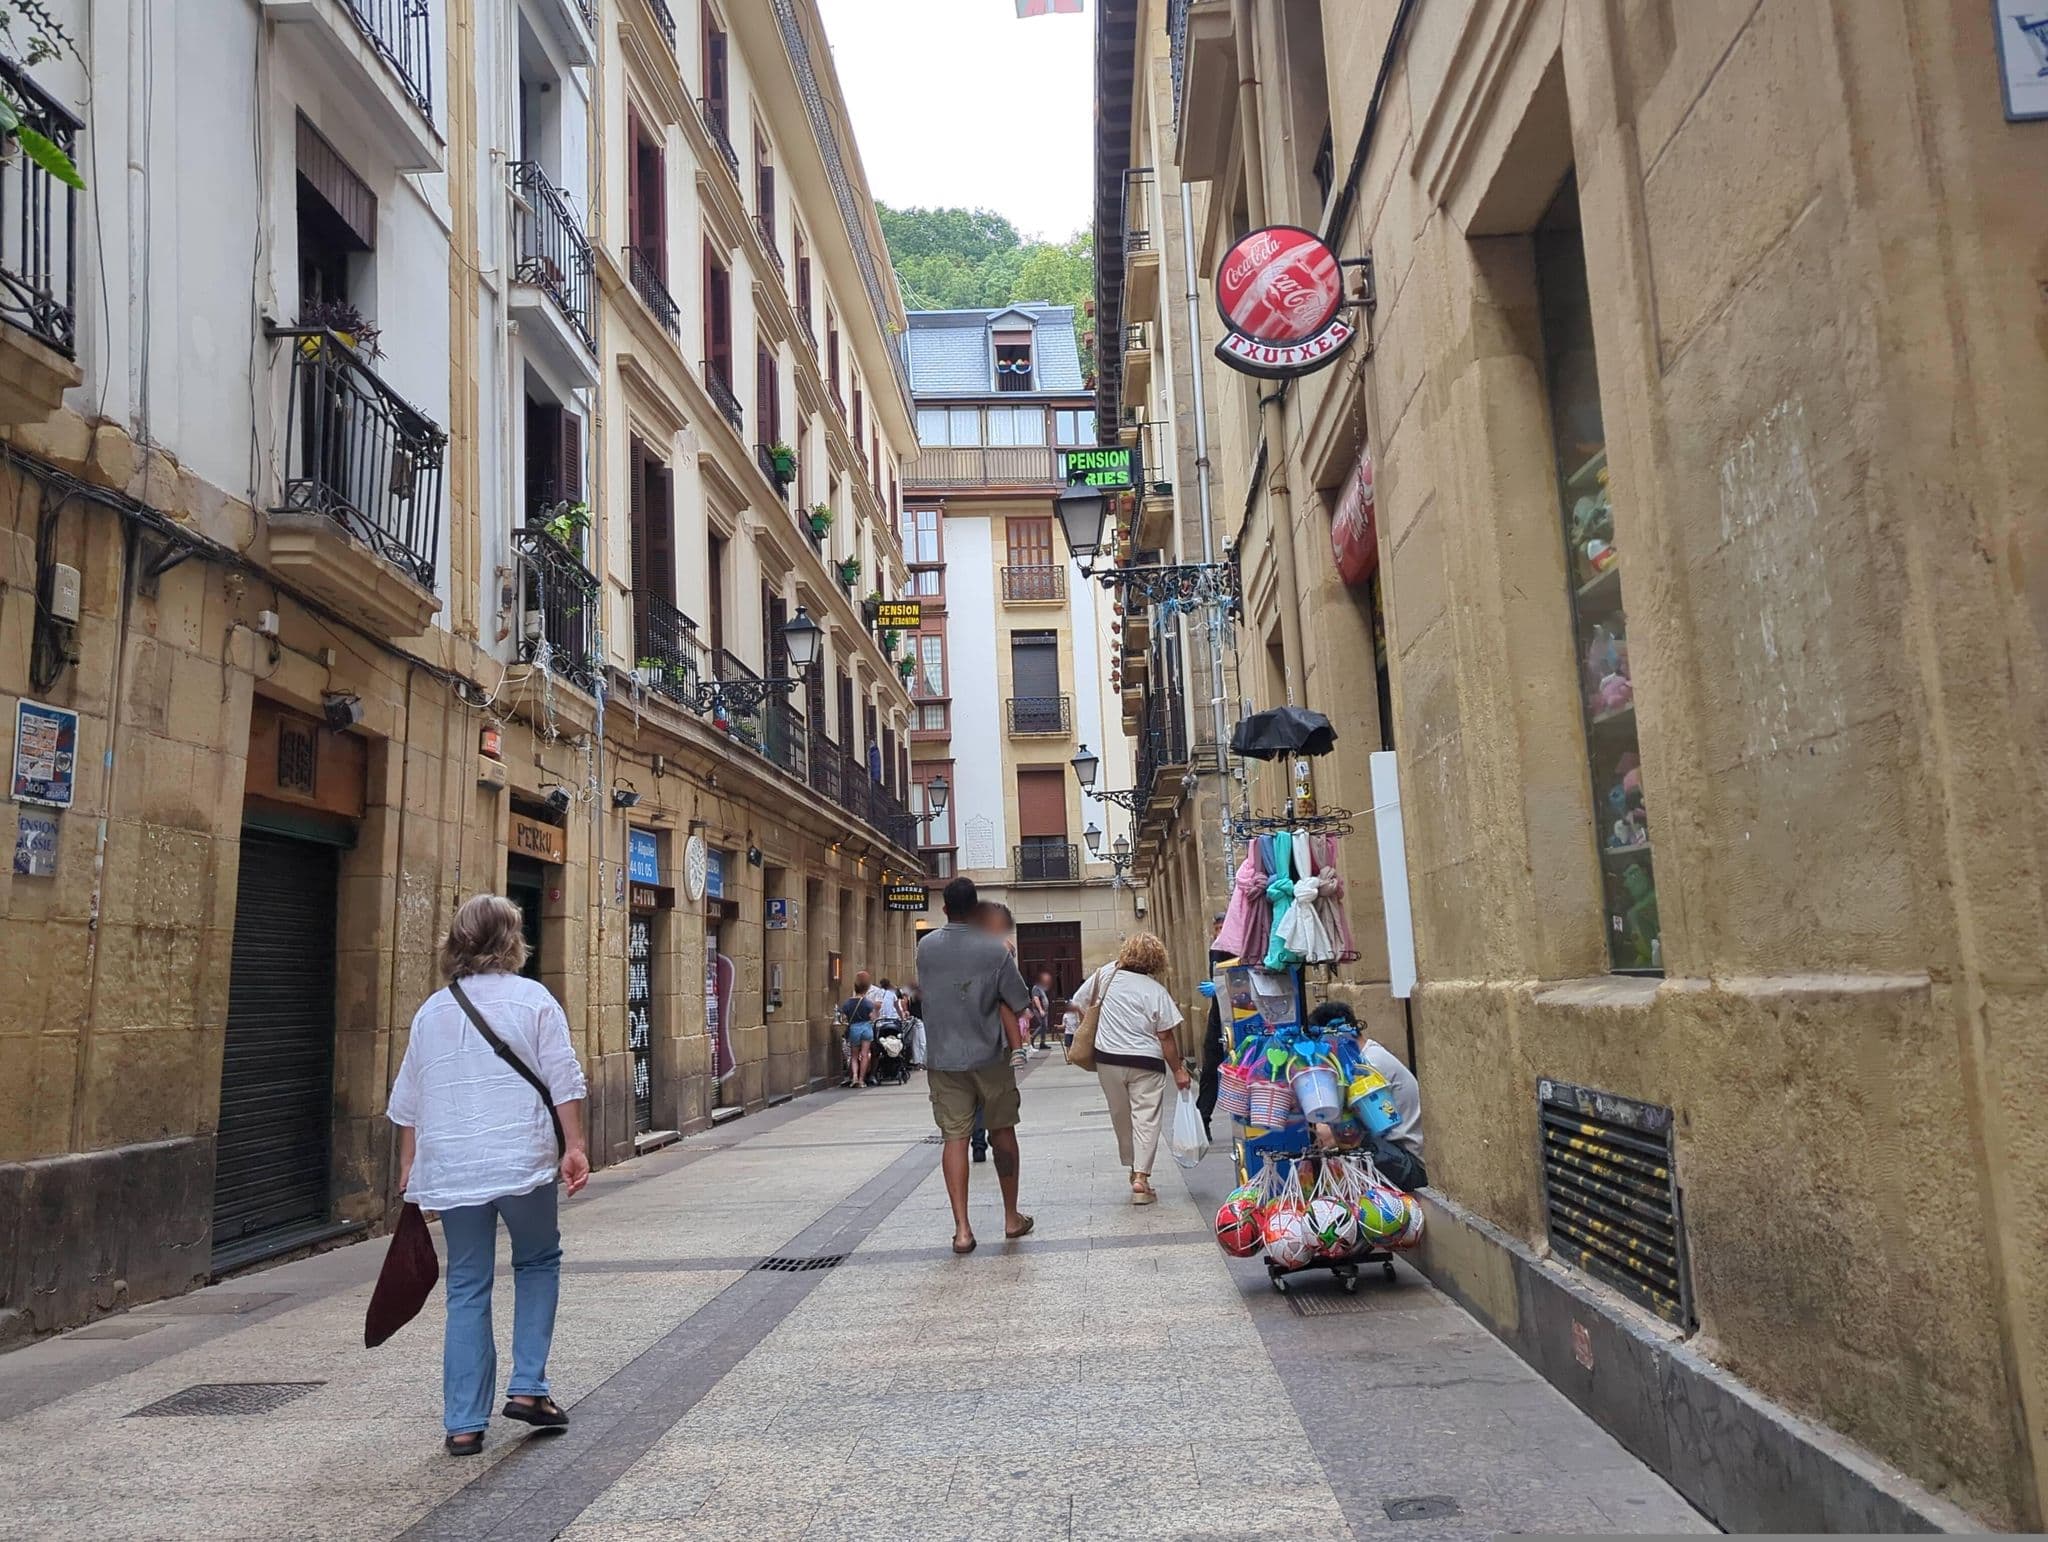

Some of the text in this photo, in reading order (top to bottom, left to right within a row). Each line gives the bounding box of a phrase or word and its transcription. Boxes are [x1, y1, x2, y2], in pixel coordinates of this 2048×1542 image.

[1225, 232, 1281, 291] Coca-Cola
[1229, 323, 1350, 363] TXUTXES
[1068, 450, 1130, 470] PENSION
[1069, 471, 1129, 486] RIES
[879, 604, 919, 616] PENSION
[516, 822, 553, 853] PERKU
[771, 901, 781, 914] P
